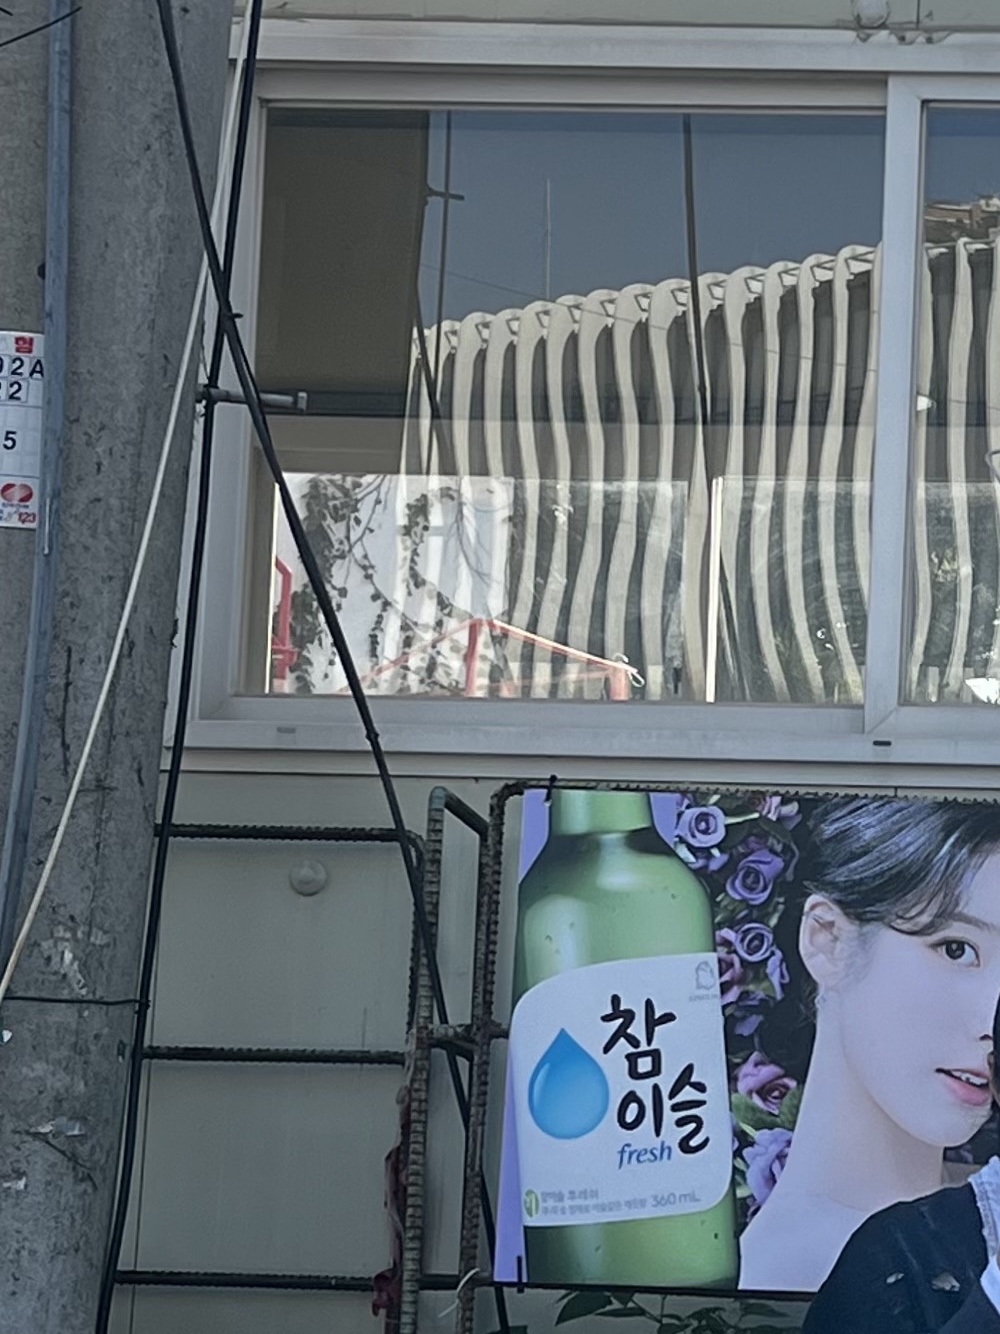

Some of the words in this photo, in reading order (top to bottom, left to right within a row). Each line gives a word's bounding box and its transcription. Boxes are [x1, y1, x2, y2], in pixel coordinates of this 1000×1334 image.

[0, 381, 22, 401] 2
[3, 431, 17, 450] 5
[617, 1140, 673, 1170] fresh
